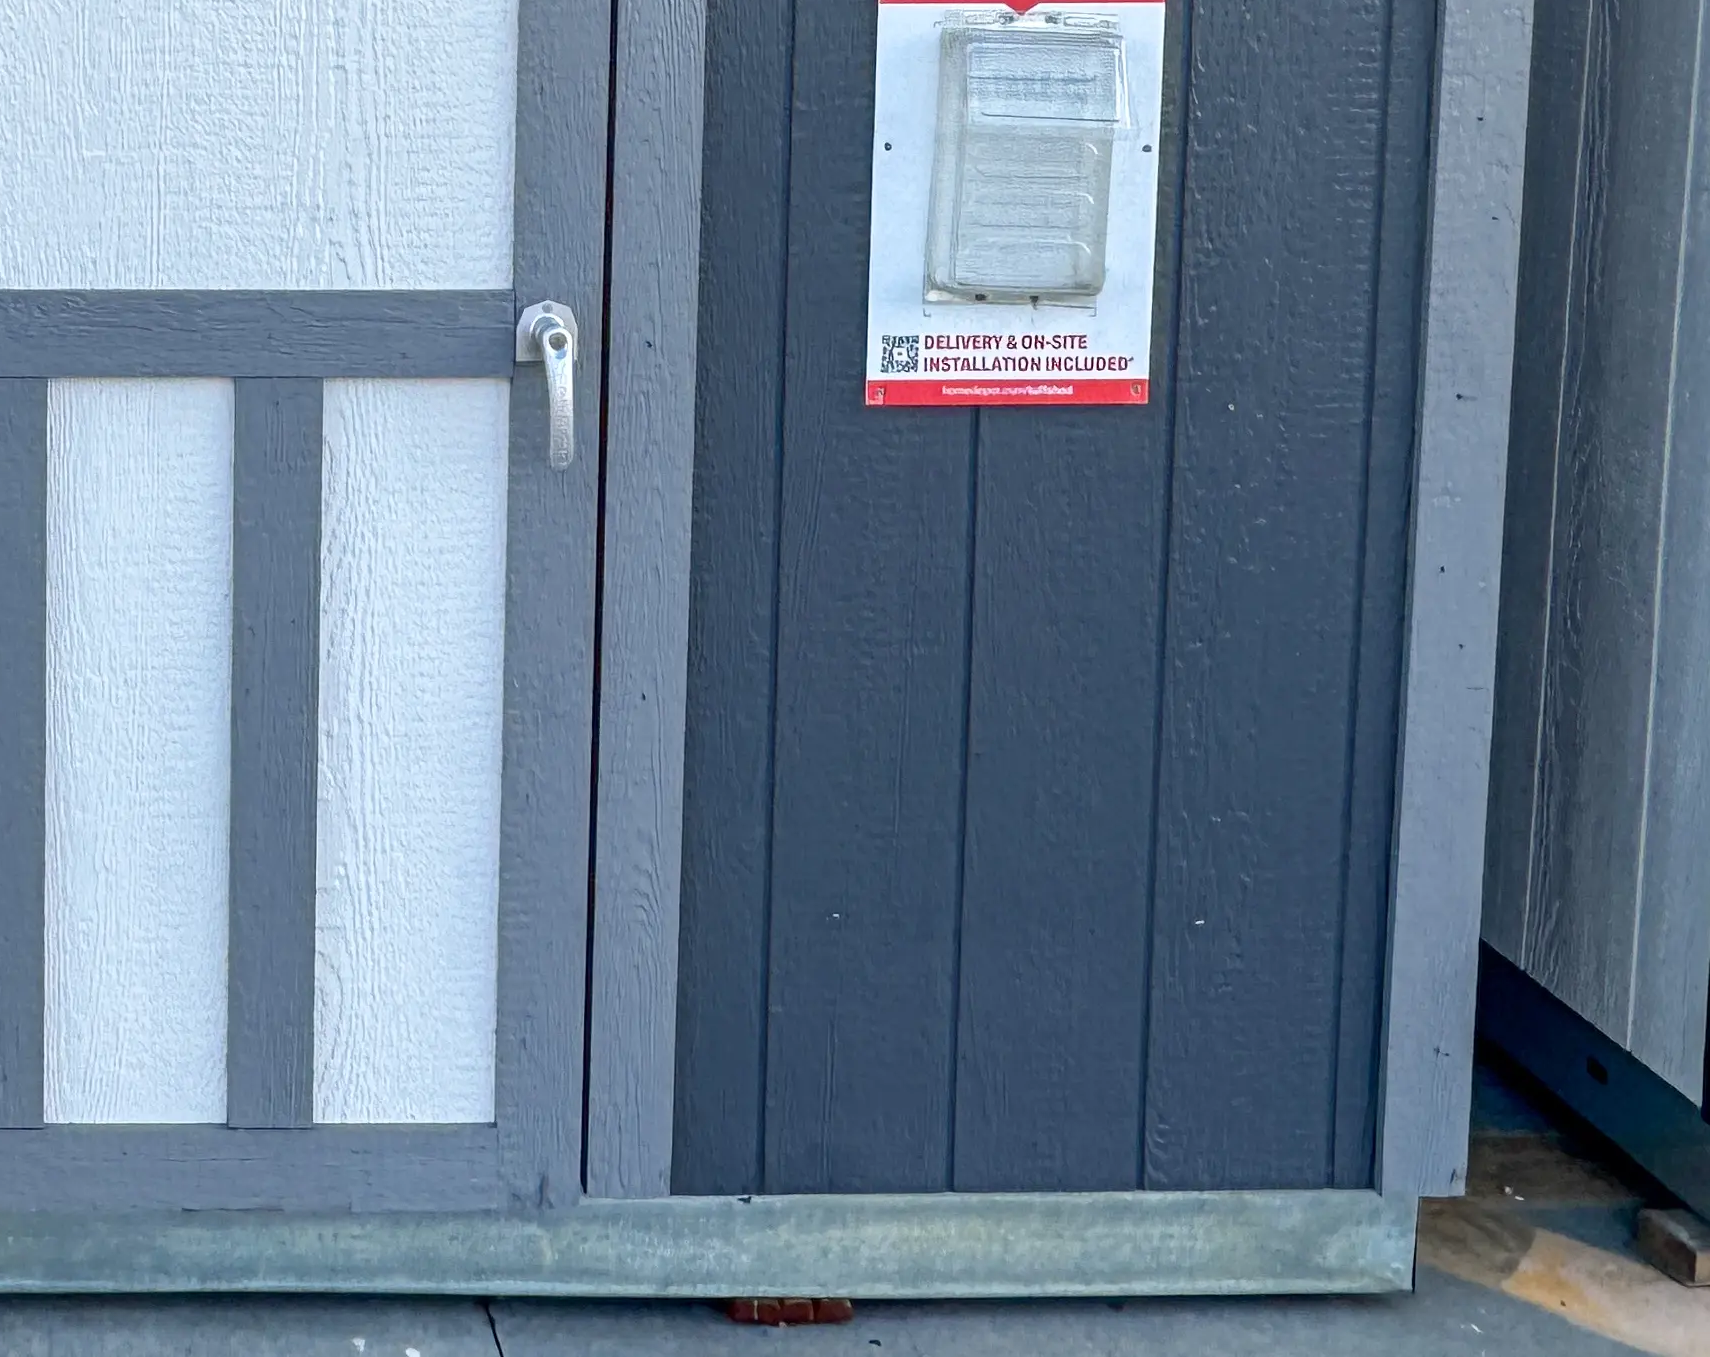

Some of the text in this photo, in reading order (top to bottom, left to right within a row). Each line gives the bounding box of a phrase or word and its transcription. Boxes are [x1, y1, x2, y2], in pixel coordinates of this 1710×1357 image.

[924, 334, 1088, 350] DELIVERY & ON-SITE
[923, 356, 1042, 372] INSTALLATION
